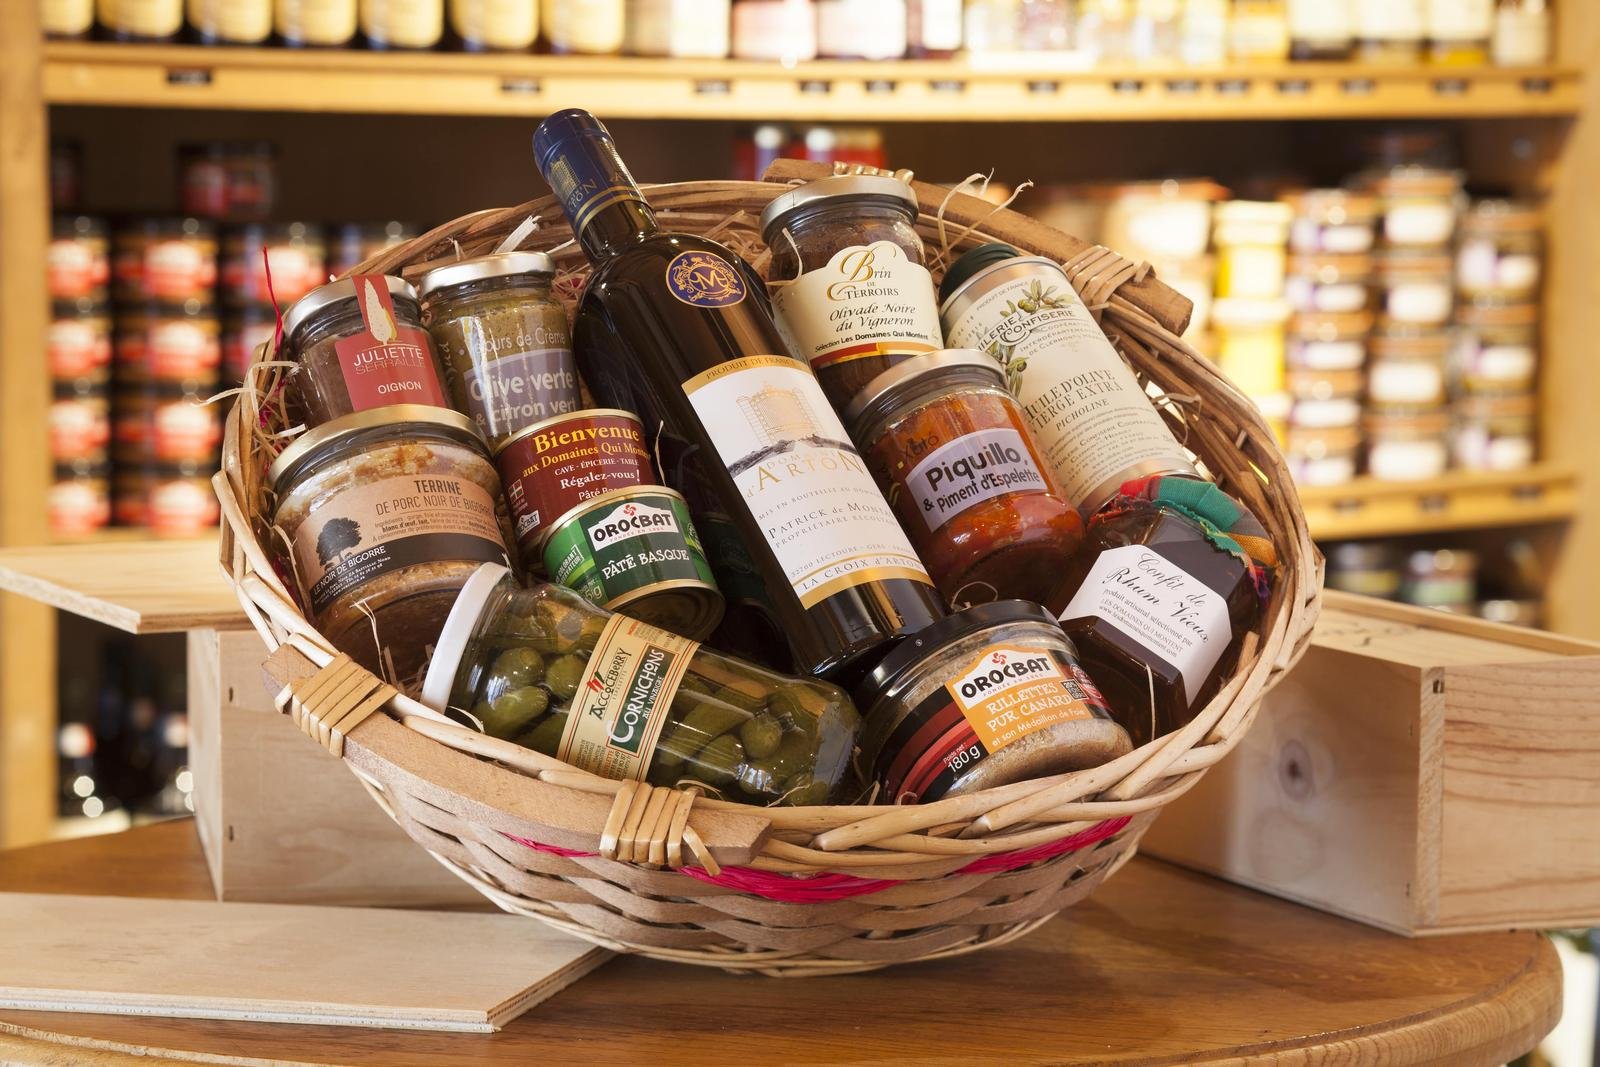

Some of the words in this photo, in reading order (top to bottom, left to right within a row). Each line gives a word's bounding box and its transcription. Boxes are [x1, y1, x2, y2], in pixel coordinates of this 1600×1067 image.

[840, 246, 891, 283] Brin
[841, 286, 899, 300] TERROIRS
[830, 302, 878, 321] Olivade
[882, 302, 916, 314] Noire
[836, 319, 853, 332] du
[859, 316, 914, 329] Vigneron
[1000, 308, 1076, 343] CONFISERIE
[516, 329, 532, 346] de
[535, 328, 565, 345] Crème
[841, 336, 853, 344] Les
[855, 331, 891, 340] Domaines
[353, 346, 424, 366] JULIETTE
[706, 360, 747, 380] PRODUIT
[378, 380, 422, 394] OIGNON
[530, 368, 573, 391] verte
[1061, 369, 1115, 394] D'OLIVE
[1078, 380, 1124, 401] EXTRA
[476, 414, 485, 426] &
[492, 402, 545, 421] citron
[1056, 398, 1110, 432] PICHOLINE
[533, 425, 639, 454] Bienvenue
[522, 463, 540, 477] aux
[541, 447, 599, 468] Domaines
[601, 442, 621, 455] Qui
[554, 465, 575, 476] CAVE
[581, 458, 616, 469] ÉPICERIE
[621, 458, 639, 466] TABLE
[413, 479, 462, 495] TERRINE
[560, 469, 635, 489] Régalez-vous
[923, 498, 935, 512] &
[937, 481, 979, 513] Piment
[980, 465, 1040, 491] d'Espelette
[375, 503, 390, 516] DE
[393, 497, 420, 513] PORC
[424, 496, 447, 507] NOIR
[450, 496, 461, 508] DE
[579, 488, 601, 501] Pâté
[776, 501, 788, 510] EN
[593, 513, 672, 542] OROCBAT
[768, 508, 828, 539] PATRICK
[832, 506, 843, 514] de
[313, 584, 320, 595] LE
[320, 571, 336, 590] NOIR
[336, 564, 348, 574] DE
[348, 546, 386, 568] BIGORRE
[601, 554, 636, 580] PÂTÉ
[639, 549, 689, 566] BASQUE
[802, 578, 818, 590] LA
[824, 558, 870, 578] CROIX
[1137, 552, 1185, 591] Confit
[1186, 593, 1207, 608] de
[1102, 567, 1160, 605] Rhum
[1170, 601, 1209, 643] Vieux
[1103, 588, 1125, 602] produit
[1125, 598, 1150, 617] artisanal
[1182, 636, 1192, 647] par
[1112, 605, 1143, 627] DOMAINES
[1143, 623, 1154, 634] QUI
[1154, 631, 1184, 653] MONTENT
[961, 657, 1051, 699] OROCBAT
[606, 649, 665, 743] CORNICHONS
[643, 709, 653, 720] AU
[648, 676, 664, 706] VINAIGRE
[986, 682, 1059, 715] RILLETTES
[987, 711, 1020, 732] PUR
[1020, 694, 1072, 717] CANARD
[992, 737, 1000, 746] et
[1001, 730, 1017, 740] son
[1059, 710, 1069, 718] de
[947, 751, 969, 772] 180
[970, 744, 981, 760] g
